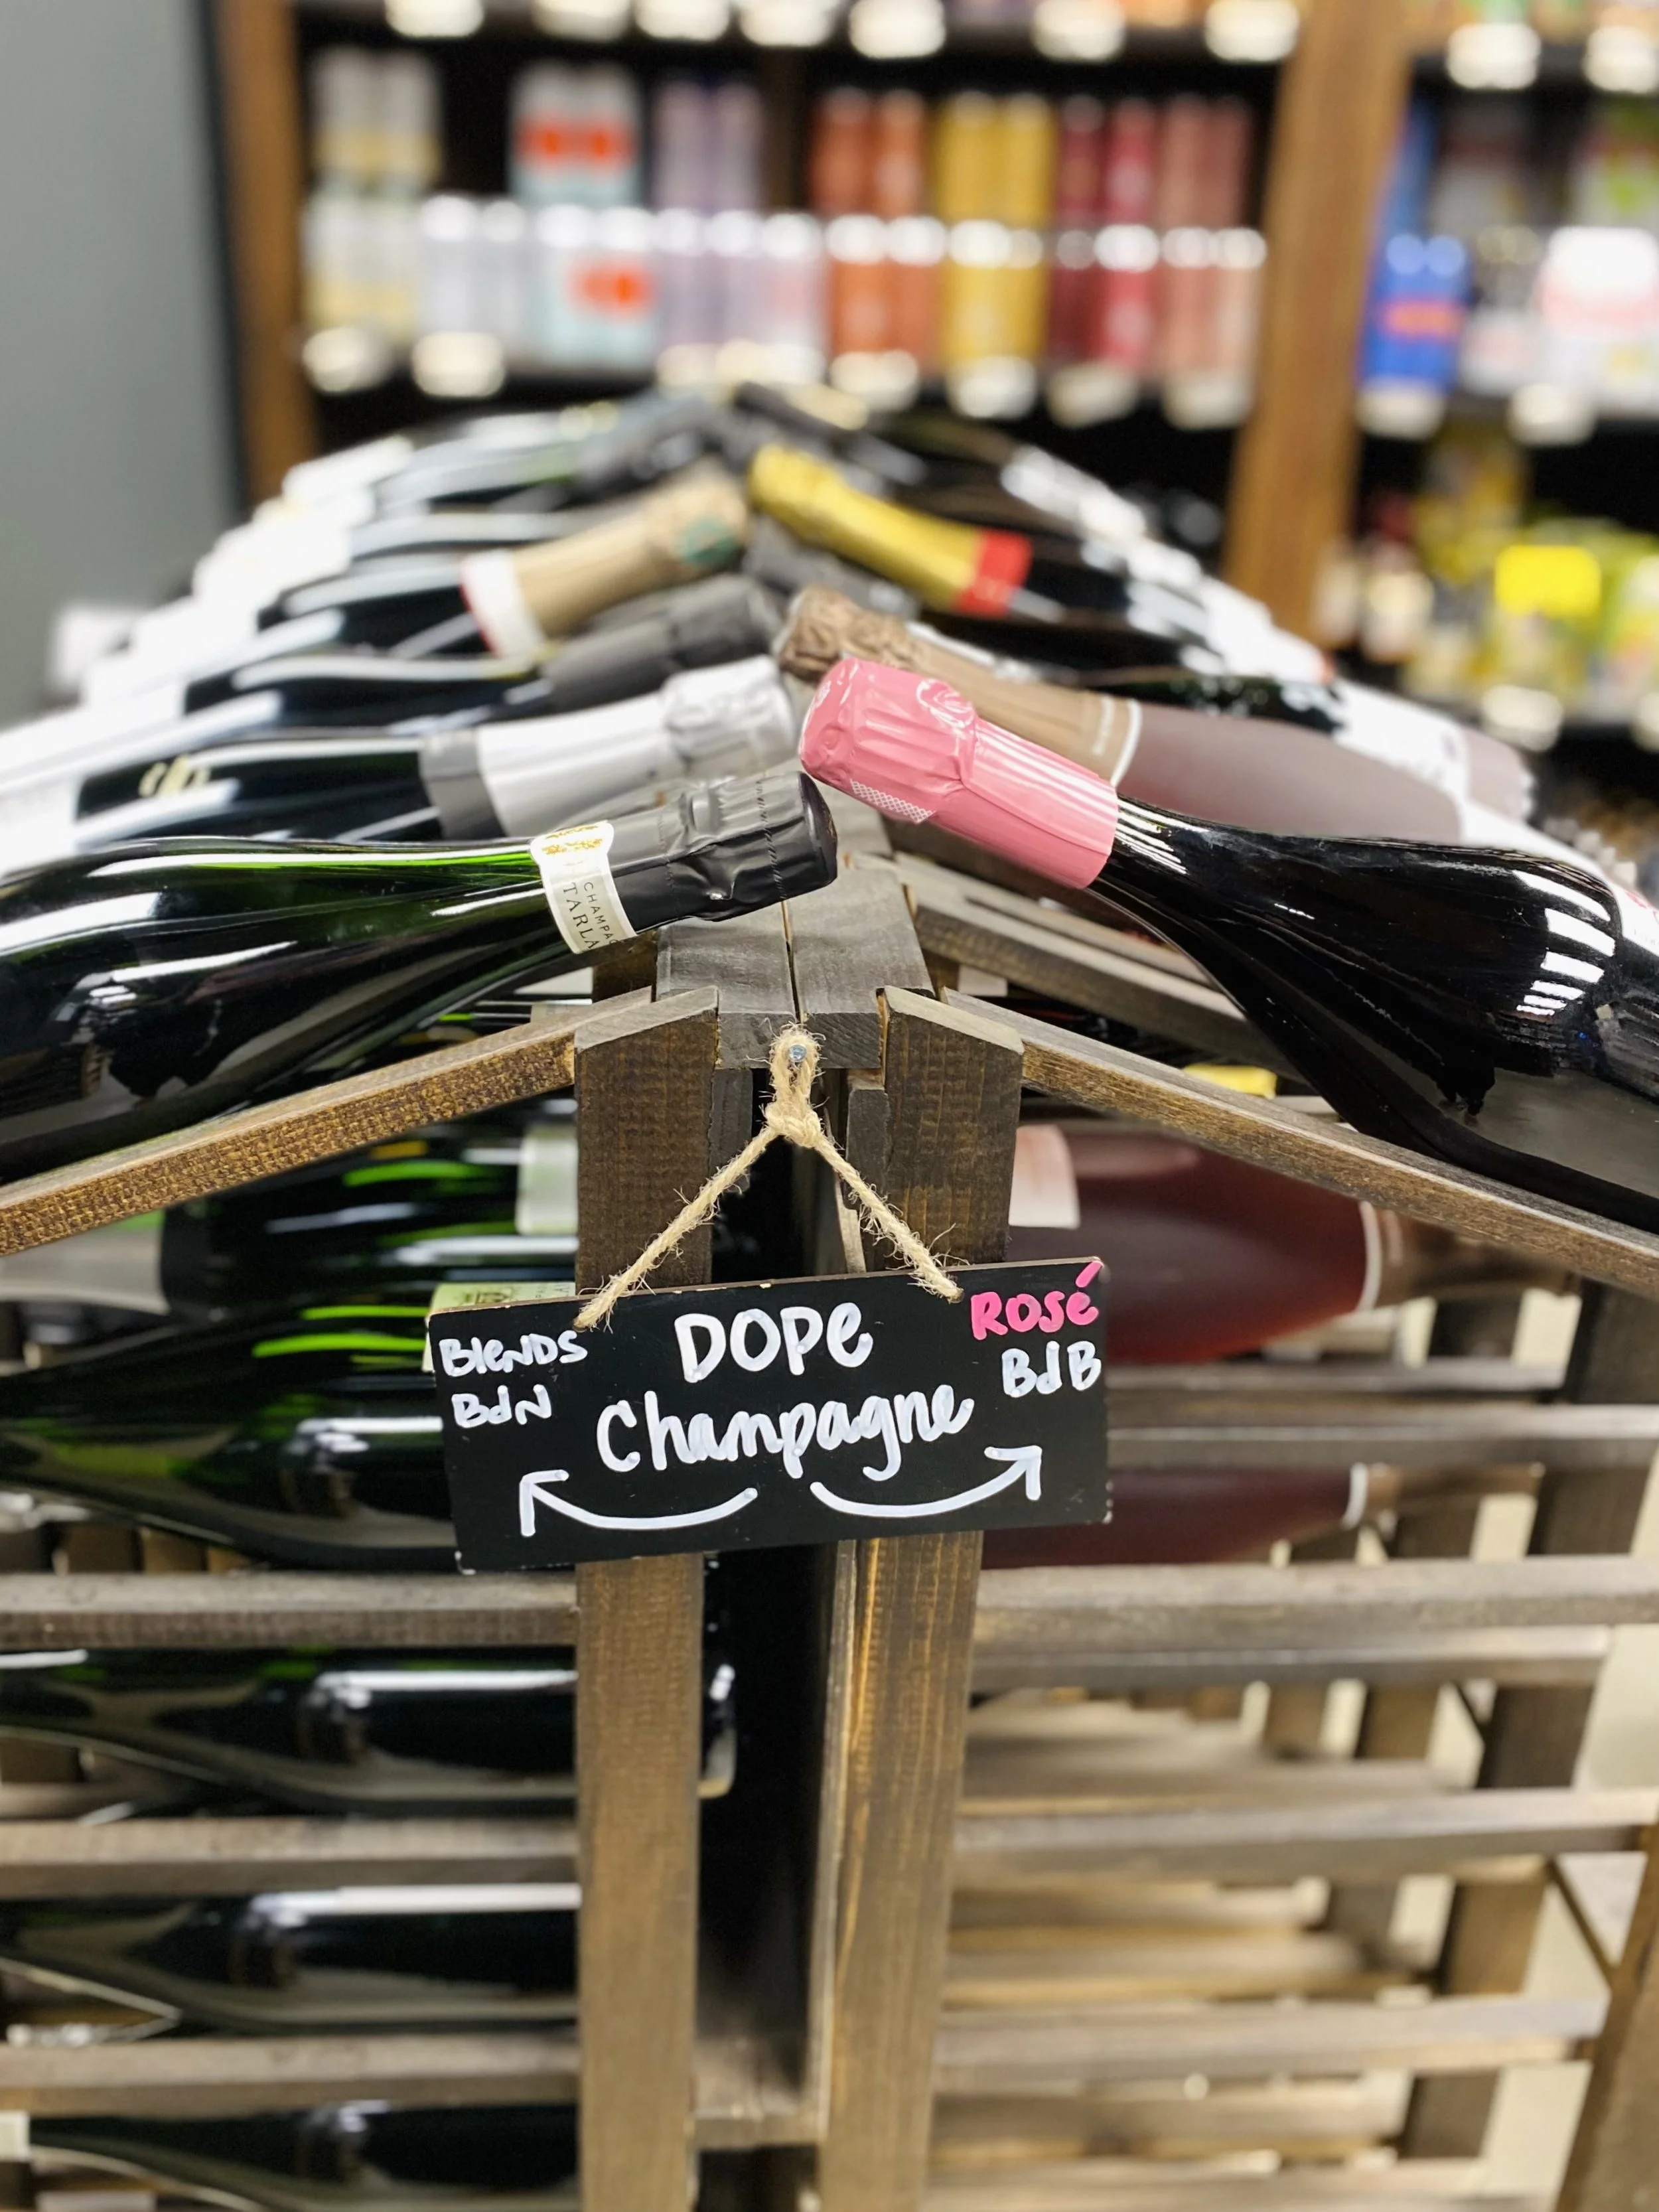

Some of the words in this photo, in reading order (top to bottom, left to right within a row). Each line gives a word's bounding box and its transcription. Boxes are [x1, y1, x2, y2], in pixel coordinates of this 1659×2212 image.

[1001, 1341, 1102, 1398] BdB
[451, 1384, 552, 1428] BdN
[597, 1384, 974, 1481] Champagne
